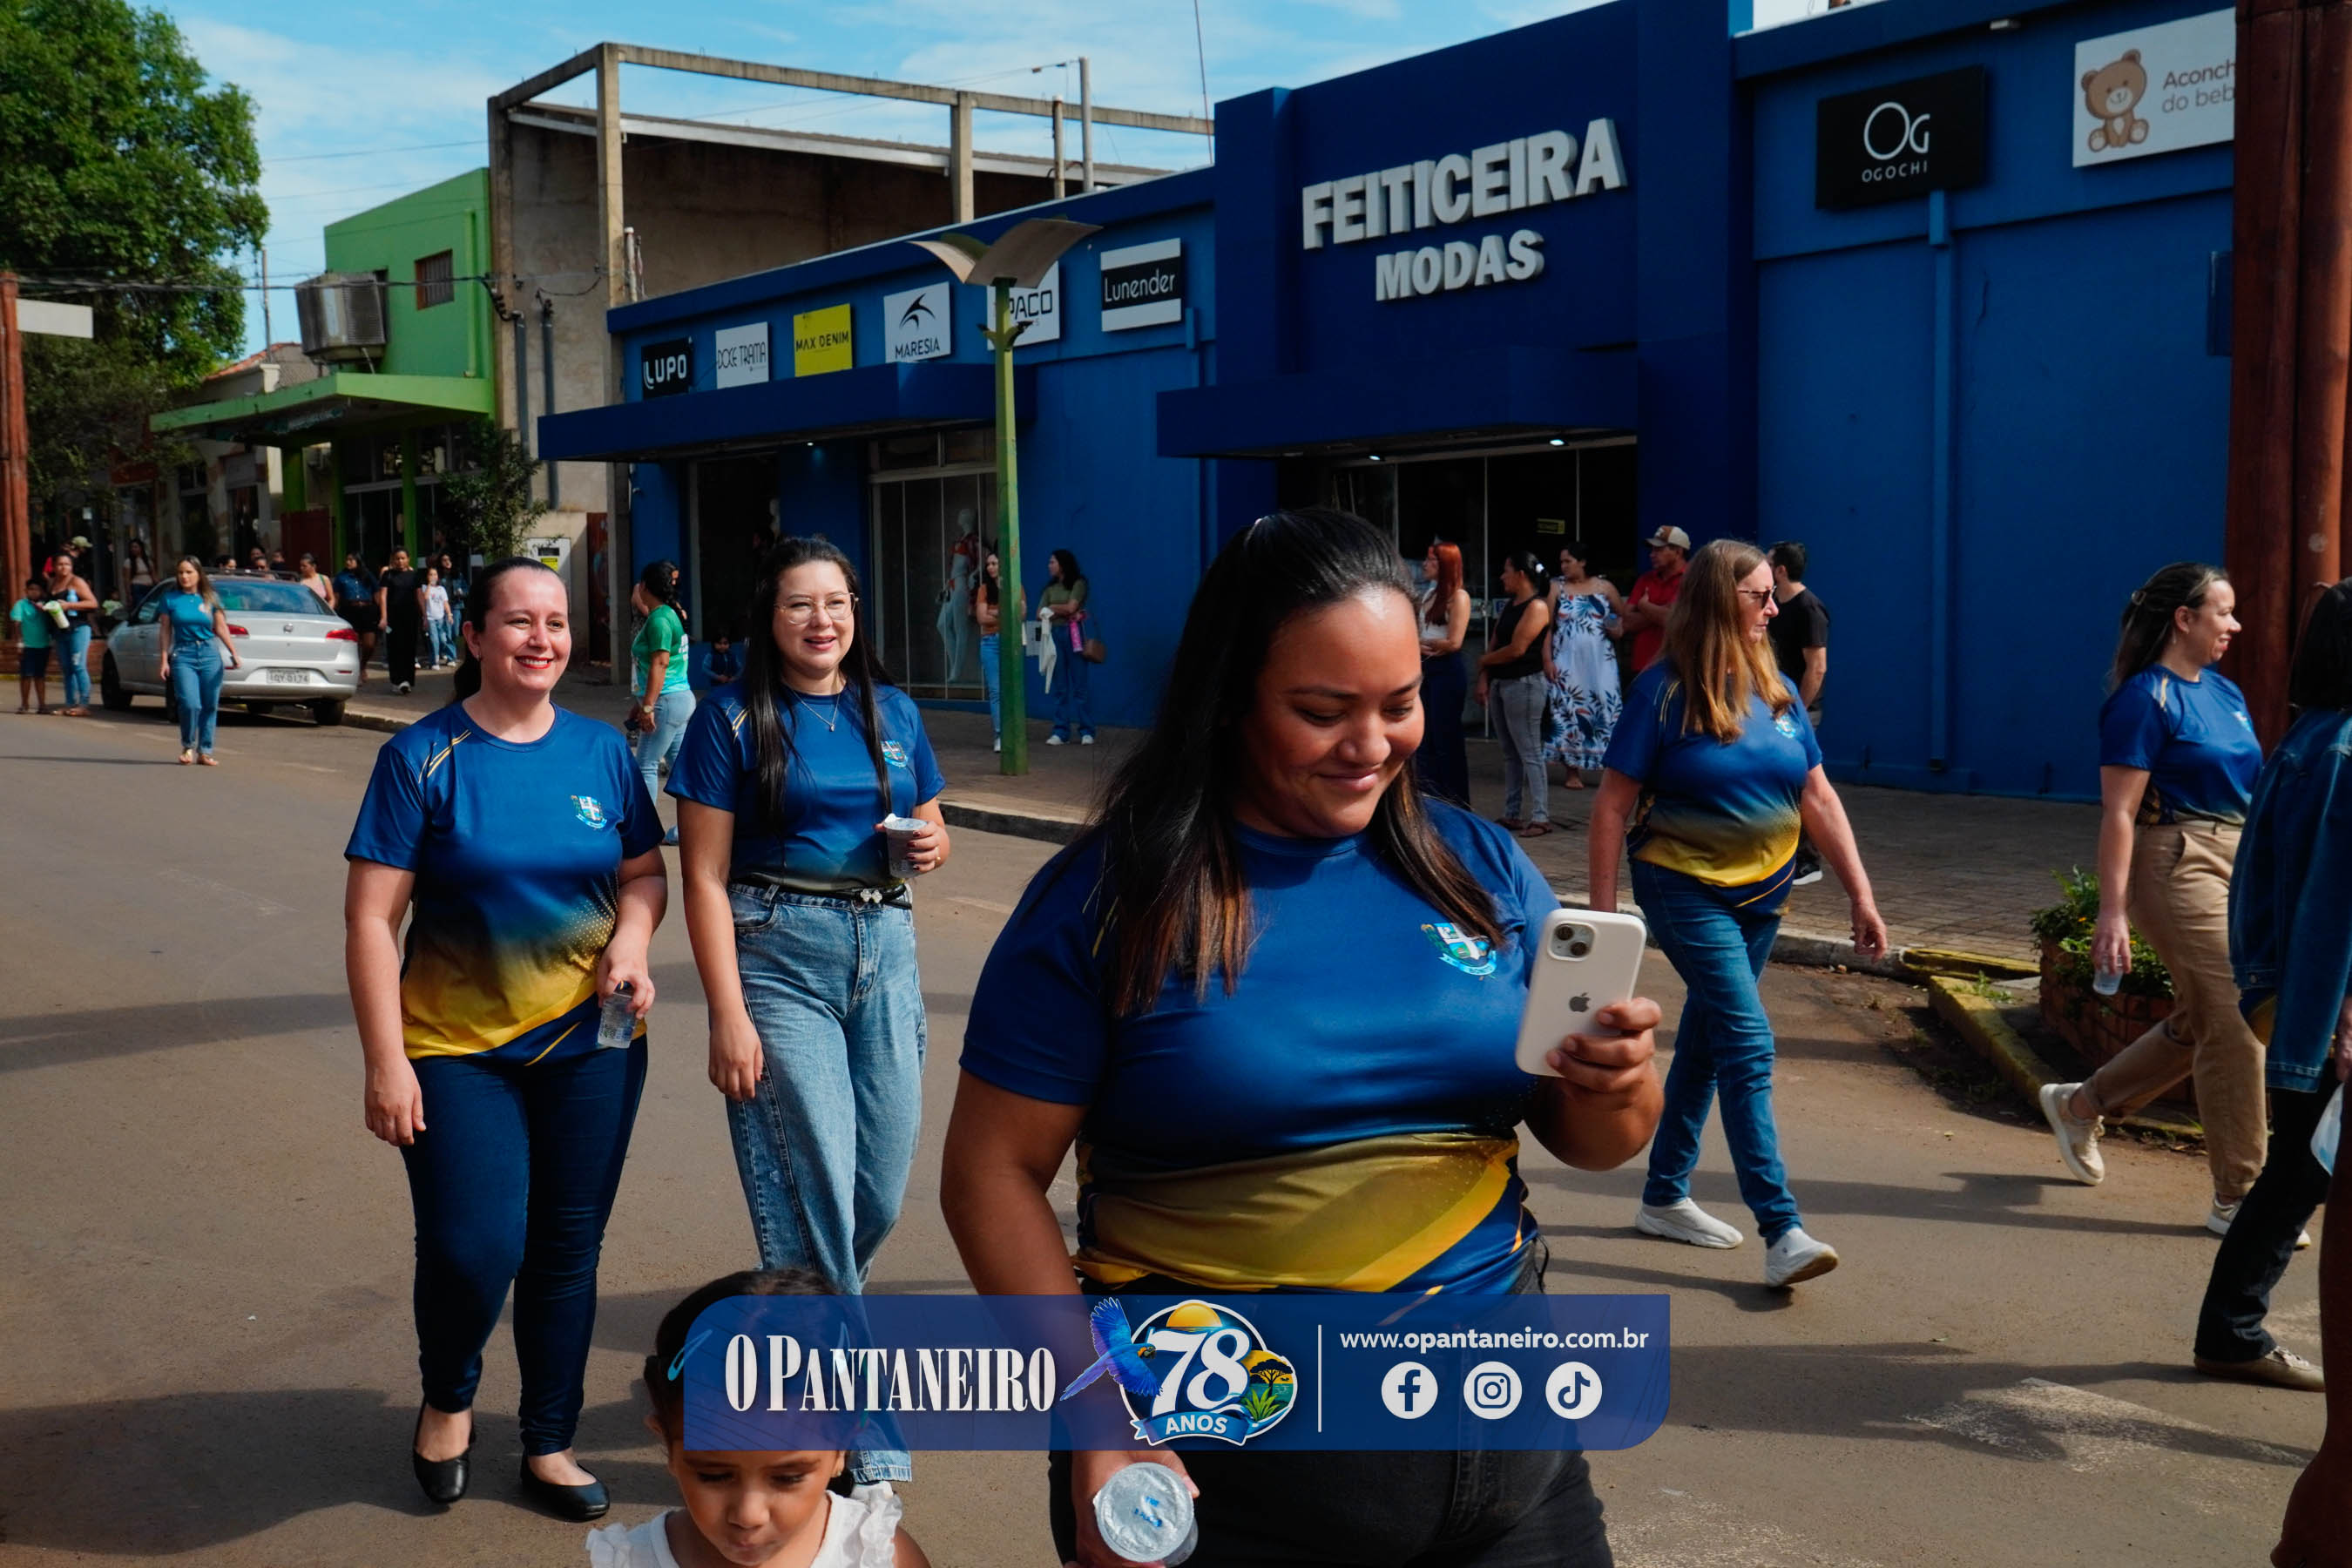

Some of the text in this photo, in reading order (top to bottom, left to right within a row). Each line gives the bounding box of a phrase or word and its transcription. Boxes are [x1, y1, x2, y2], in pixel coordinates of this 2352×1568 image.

[2162, 93, 2189, 113] do
[1302, 118, 1627, 250] FEITICEIRA
[1862, 160, 1927, 182] OGOCHI
[1375, 229, 1544, 301] MODAS
[1105, 268, 1176, 302] Lunender
[718, 341, 767, 369] DOCE TRAMA
[796, 331, 849, 352] MAX DENIM
[895, 336, 941, 359] MARESIA
[643, 354, 687, 390] LUPO
